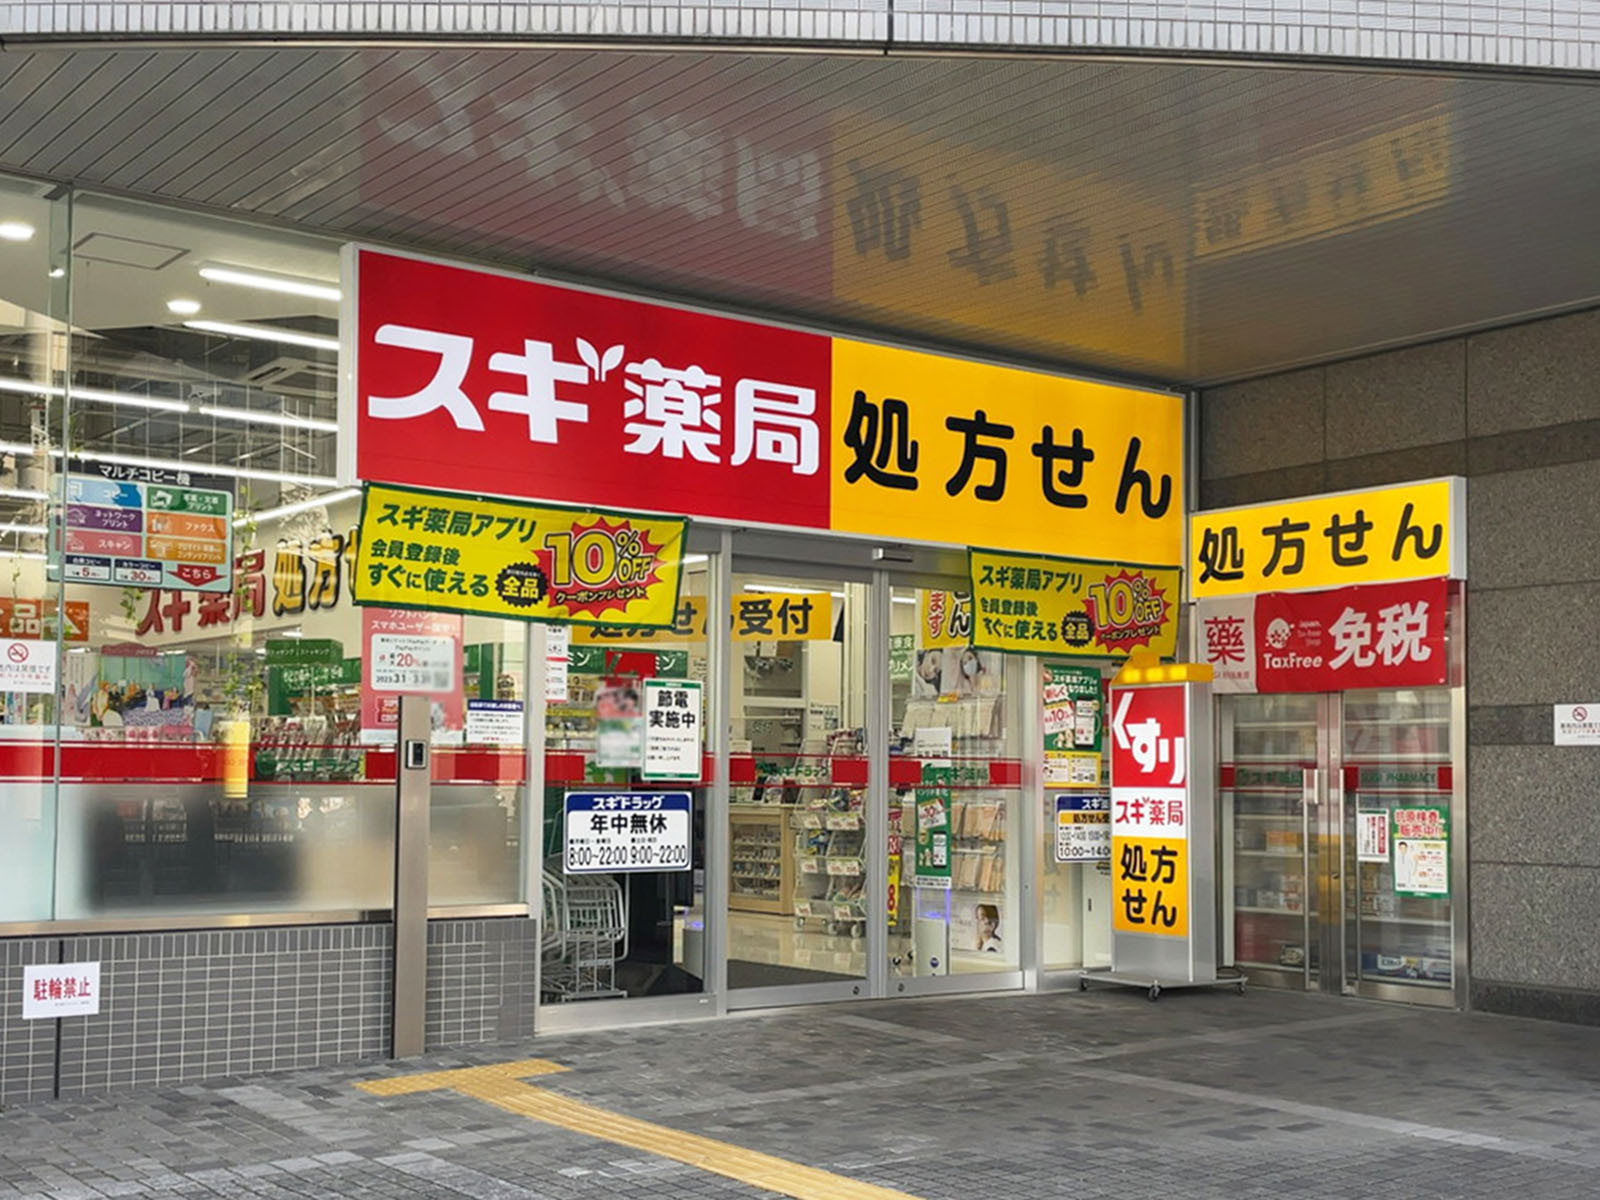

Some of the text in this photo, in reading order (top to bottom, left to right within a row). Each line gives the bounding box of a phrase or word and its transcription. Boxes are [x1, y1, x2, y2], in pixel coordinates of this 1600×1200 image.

[368, 323, 820, 476] スギ薬局
[844, 390, 1172, 519] 処方せん
[376, 503, 537, 543] スギ薬局アプリ
[371, 539, 461, 567] 会員登録後
[1199, 503, 1443, 584] 処方せん
[368, 561, 490, 597] すぐに使える
[502, 575, 539, 599] 全品
[979, 565, 1083, 594] スギ薬局アプリ
[556, 586, 645, 604] クーポンプレゼント
[981, 597, 1038, 616] 会員登録後
[983, 617, 1058, 641] すぐに使える
[1064, 621, 1089, 641] 全品
[1328, 601, 1432, 670] 免税
[658, 690, 688, 708] 節電
[649, 710, 696, 729] 実施中
[1113, 692, 1185, 785] くすり
[592, 796, 665, 810] スギドラッグ
[1115, 797, 1184, 826] スギ薬局
[590, 813, 668, 834] 年中無休
[1121, 843, 1178, 884] 処方
[1122, 888, 1177, 927] せん
[34, 976, 91, 1001] 駐輪禁止
